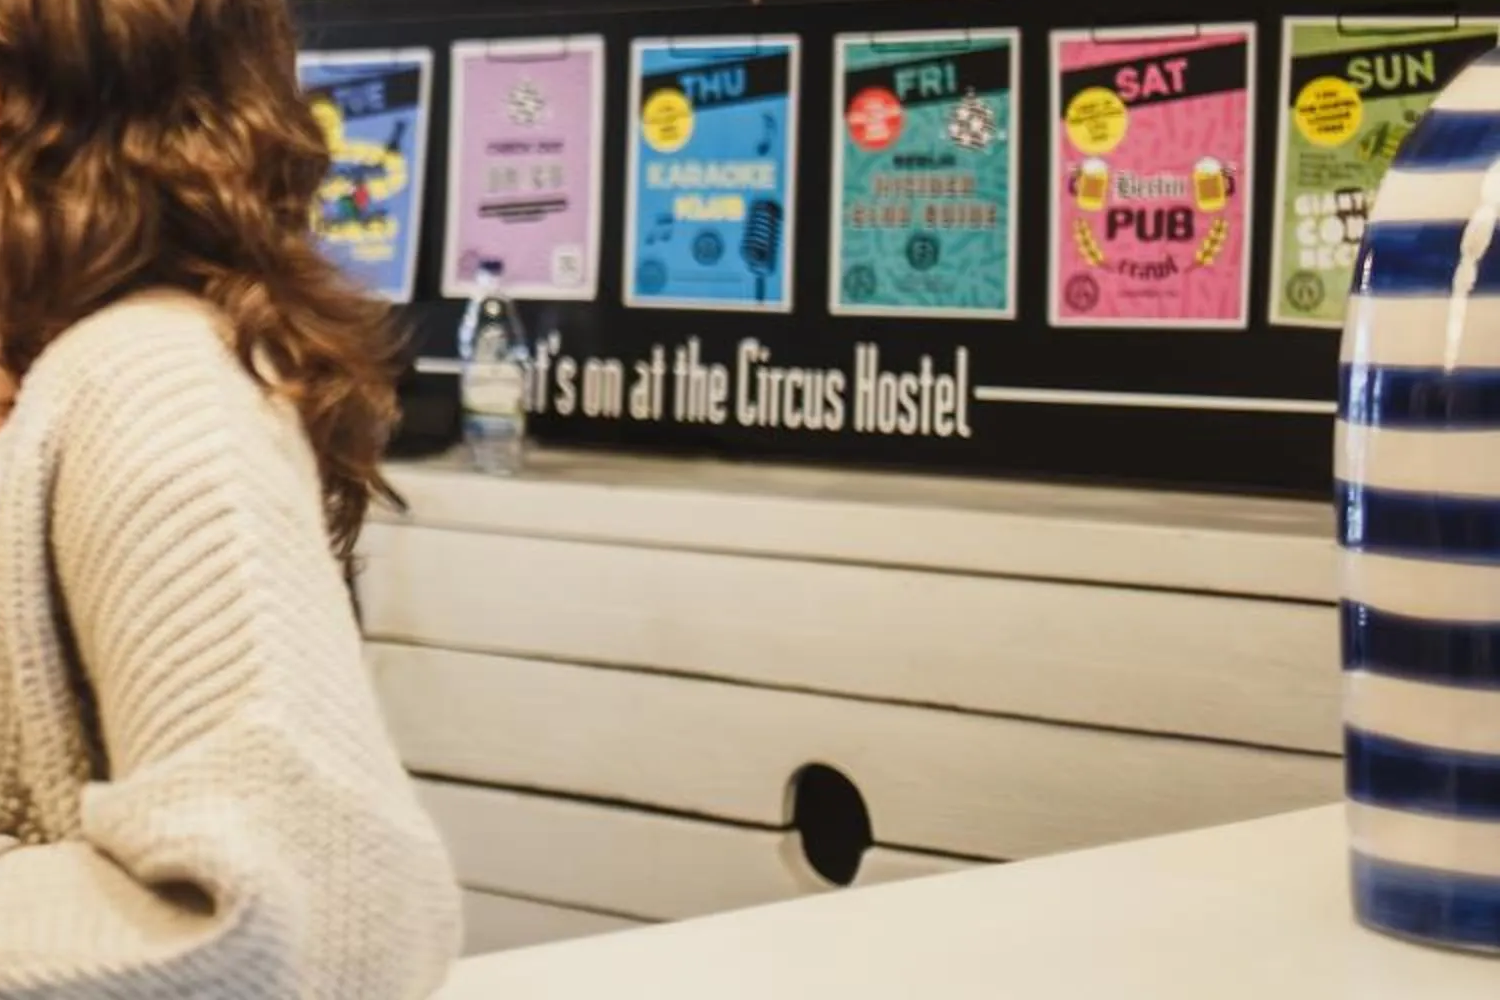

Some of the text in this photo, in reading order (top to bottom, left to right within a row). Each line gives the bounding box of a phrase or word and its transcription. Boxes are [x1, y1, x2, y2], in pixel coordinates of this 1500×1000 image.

[678, 68, 746, 100] THU
[893, 62, 958, 99] FRI
[1114, 57, 1188, 102] SAT
[1347, 49, 1436, 91] SUN
[1106, 205, 1195, 242] PUB
[582, 355, 625, 419] on
[629, 343, 666, 422] at
[673, 335, 729, 425] the
[736, 336, 846, 431] Circus
[853, 341, 973, 439] Hostel
